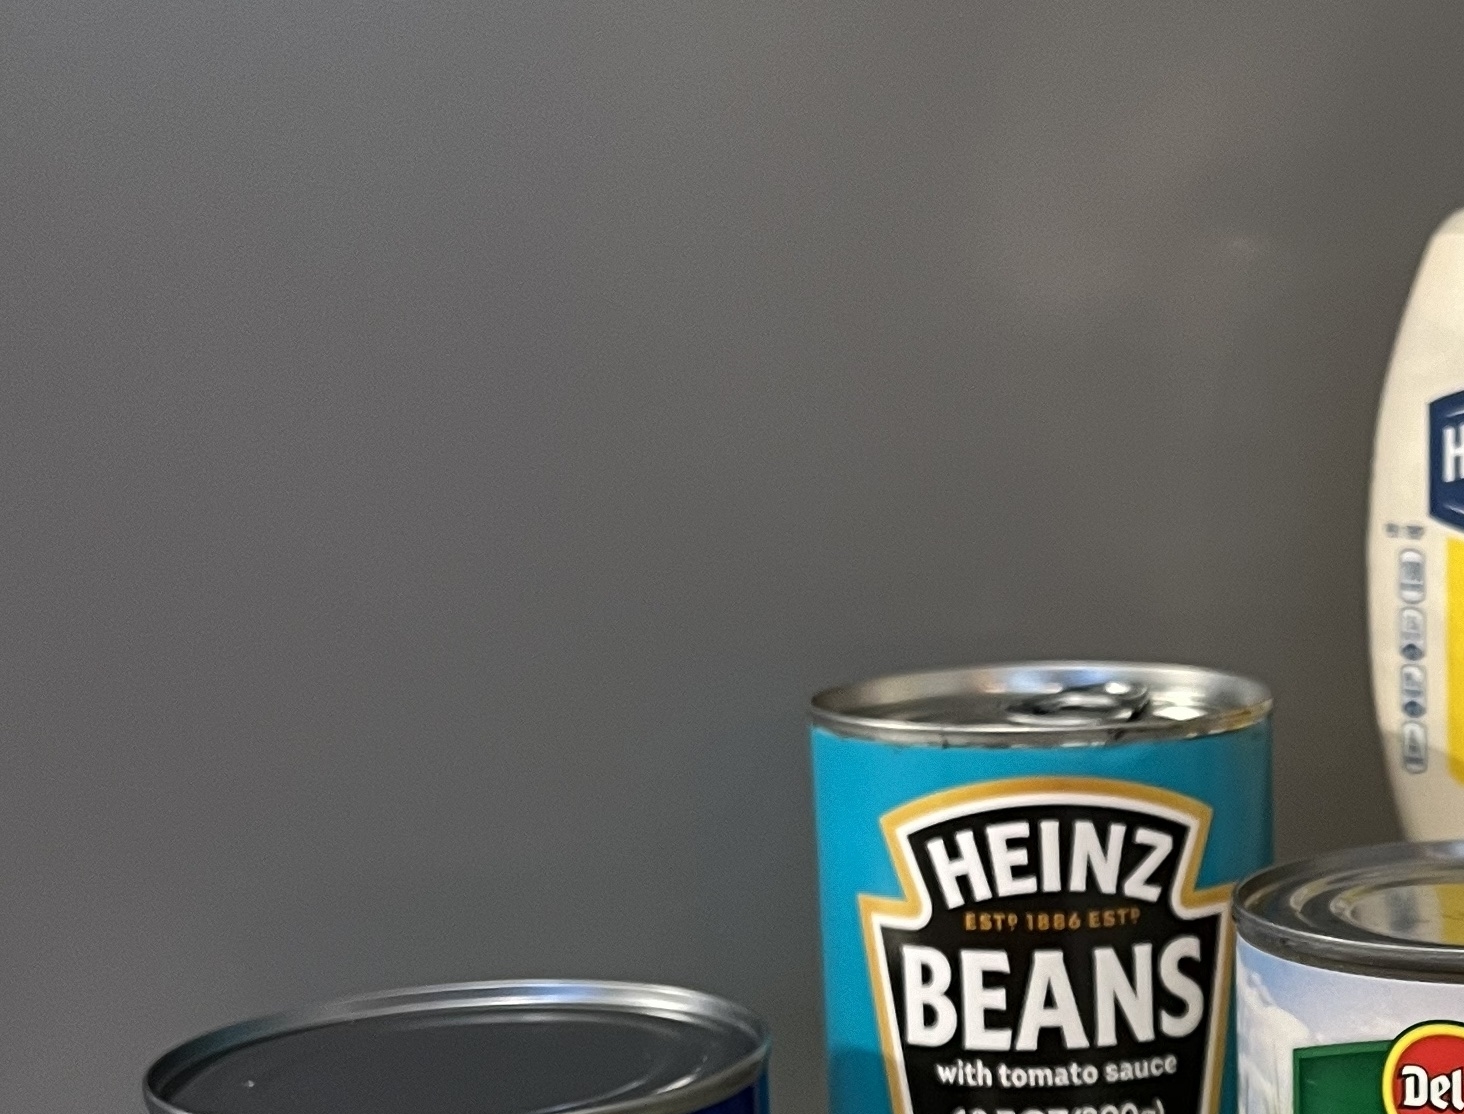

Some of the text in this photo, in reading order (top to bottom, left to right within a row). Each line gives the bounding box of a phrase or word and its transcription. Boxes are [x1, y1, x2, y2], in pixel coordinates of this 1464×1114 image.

[926, 819, 1173, 910] HEINZ
[901, 935, 1204, 1052] BEANS
[936, 1054, 1178, 1088] with tomato sauce
